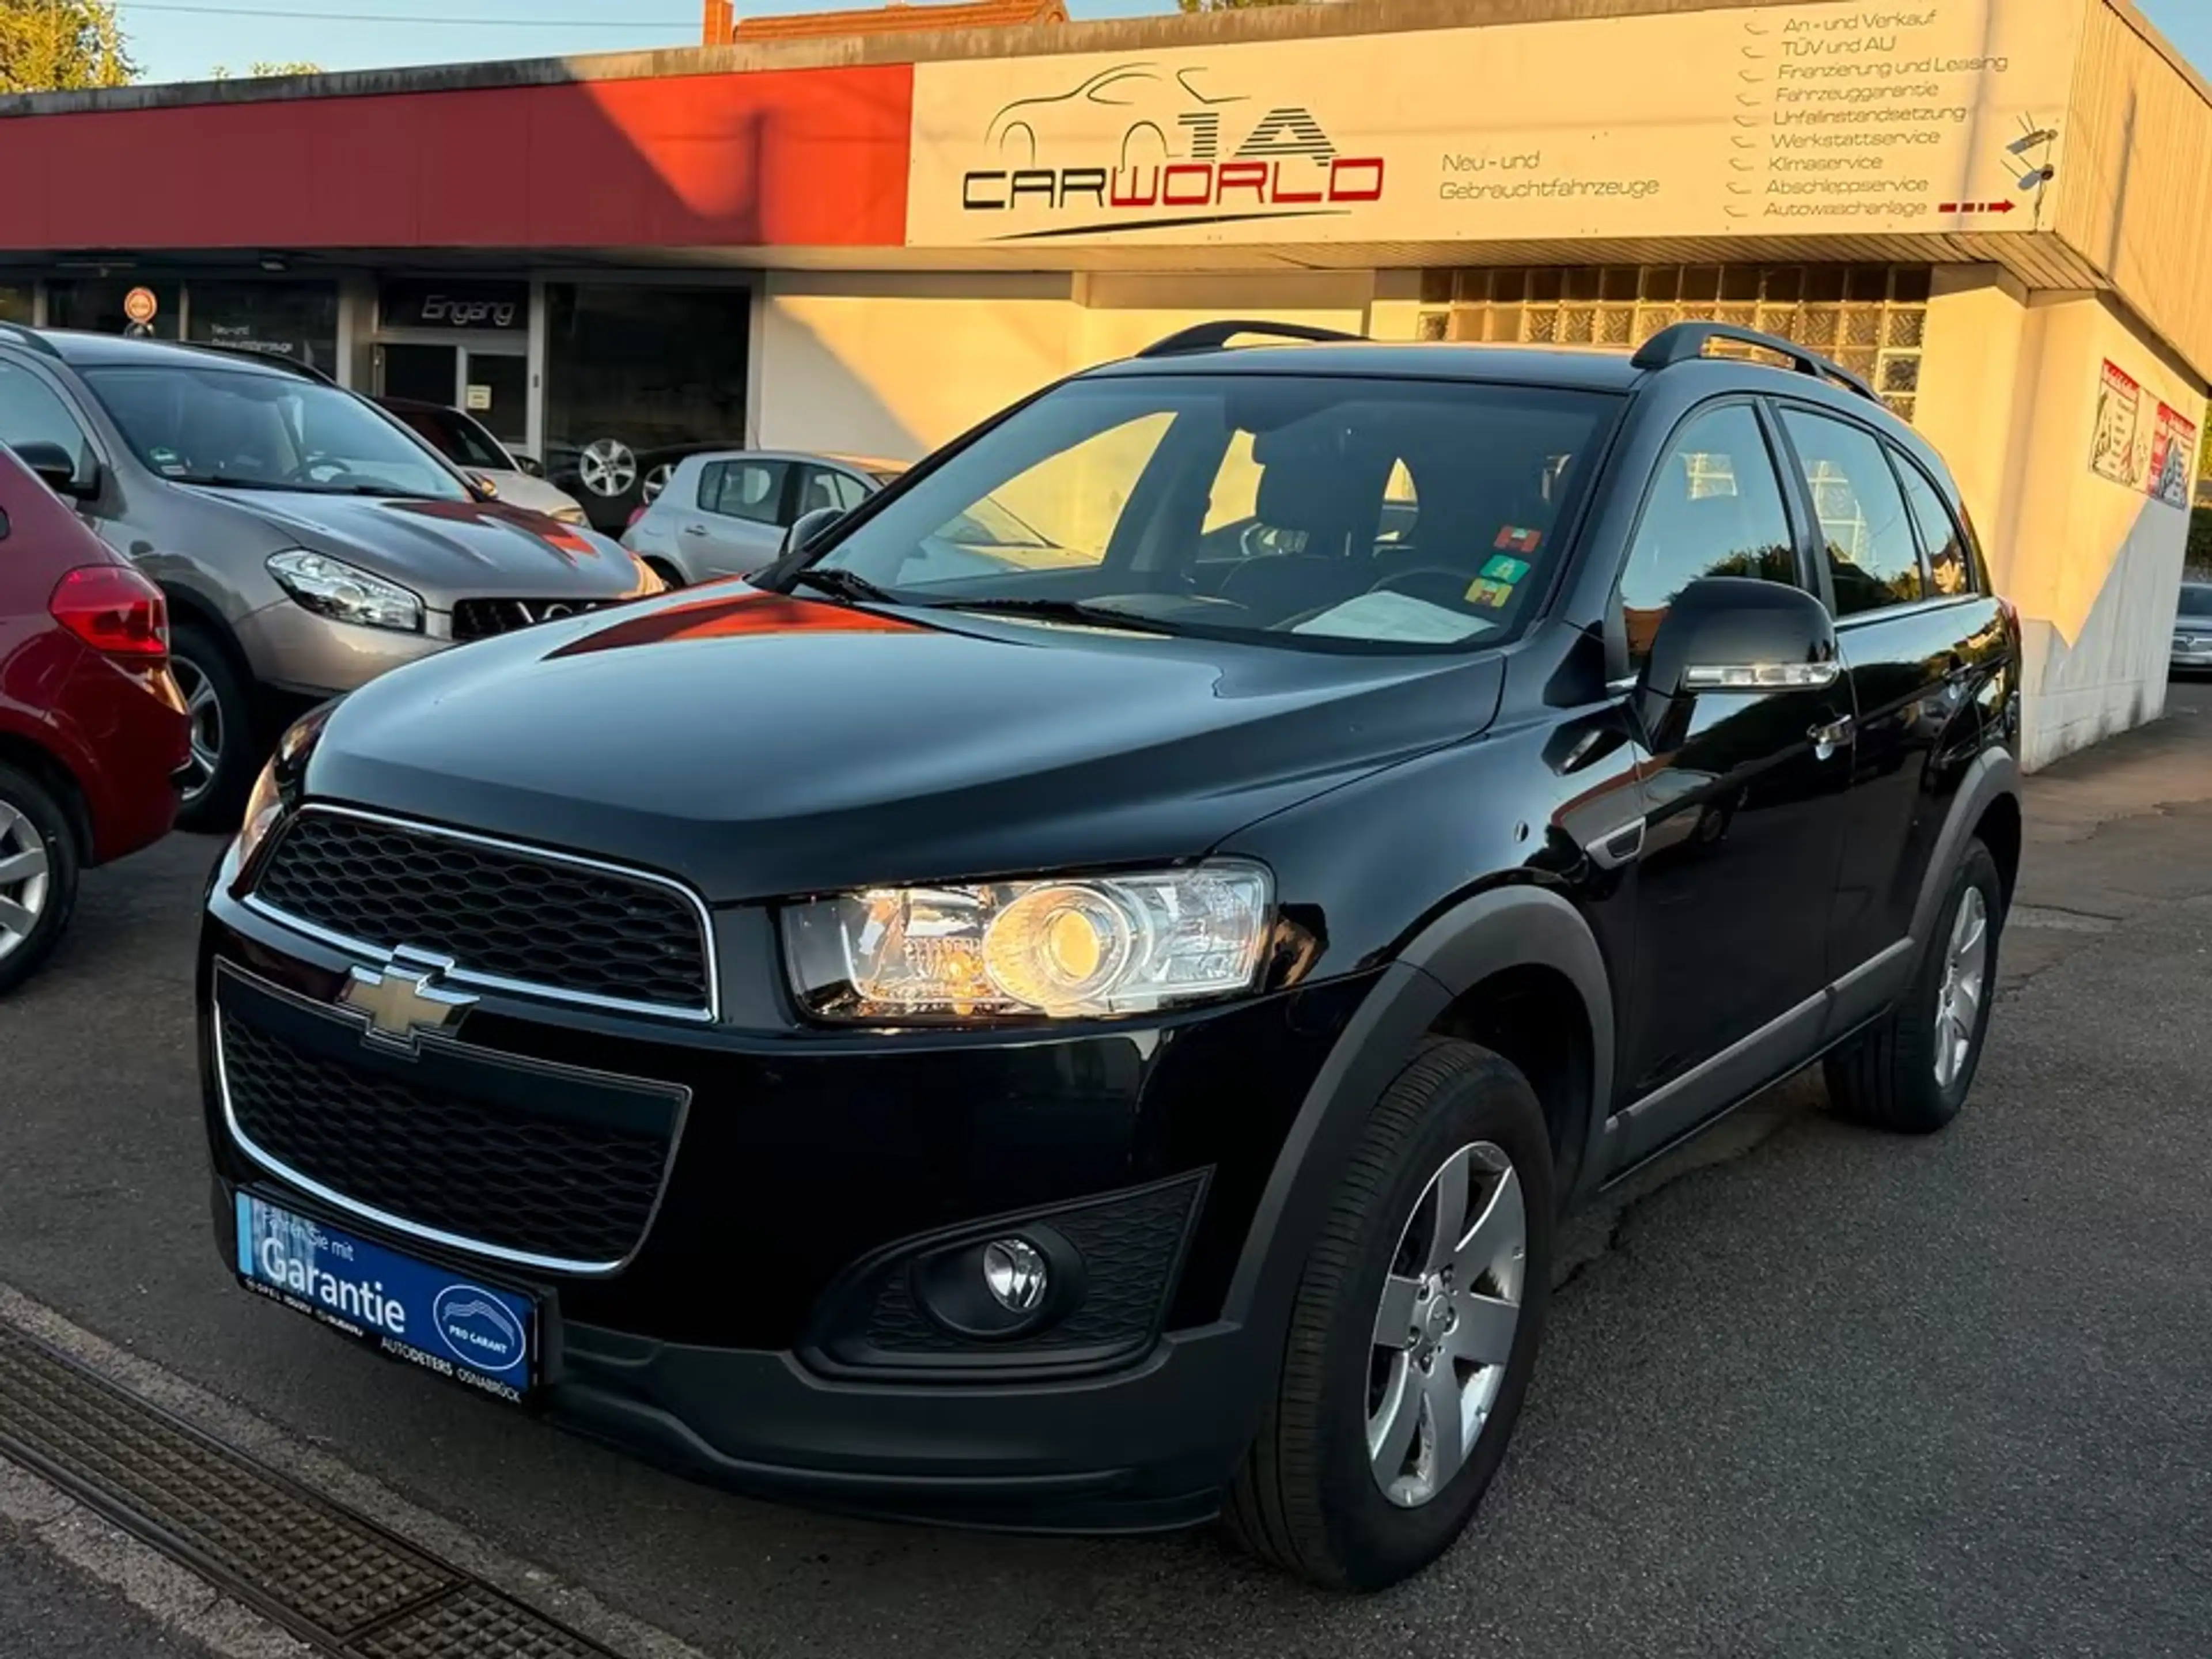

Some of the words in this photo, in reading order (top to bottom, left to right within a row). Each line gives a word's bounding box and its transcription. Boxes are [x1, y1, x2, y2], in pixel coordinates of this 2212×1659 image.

[1824, 14, 1859, 31] und
[1862, 9, 1937, 29] Verkauf
[1781, 37, 1825, 56] TÜV
[1827, 38, 1862, 54] und
[1864, 35, 1896, 52] AU
[1778, 62, 1892, 79] Finanzierung
[1895, 58, 1931, 75] und
[1934, 57, 2008, 73] Leasing
[1775, 81, 1939, 103] Fahrzeuggarantie
[1774, 107, 1967, 126] Unfallinstandsetzung
[1771, 130, 1941, 148] Werkstattservice
[1500, 150, 1541, 169] und
[1767, 156, 1884, 172] Klimaservice
[1440, 178, 1660, 199] Gebrauchtfahrzeuge
[1765, 177, 1929, 195] Abschleppservice
[1763, 201, 1927, 218] Autowaschanlage
[422, 294, 516, 327] Eingang
[331, 1240, 354, 1262] mit
[262, 1237, 406, 1334] Garantie
[449, 1324, 469, 1340] PRO
[469, 1331, 508, 1354] GARANT
[456, 1367, 522, 1404] OSNABRÜCK
